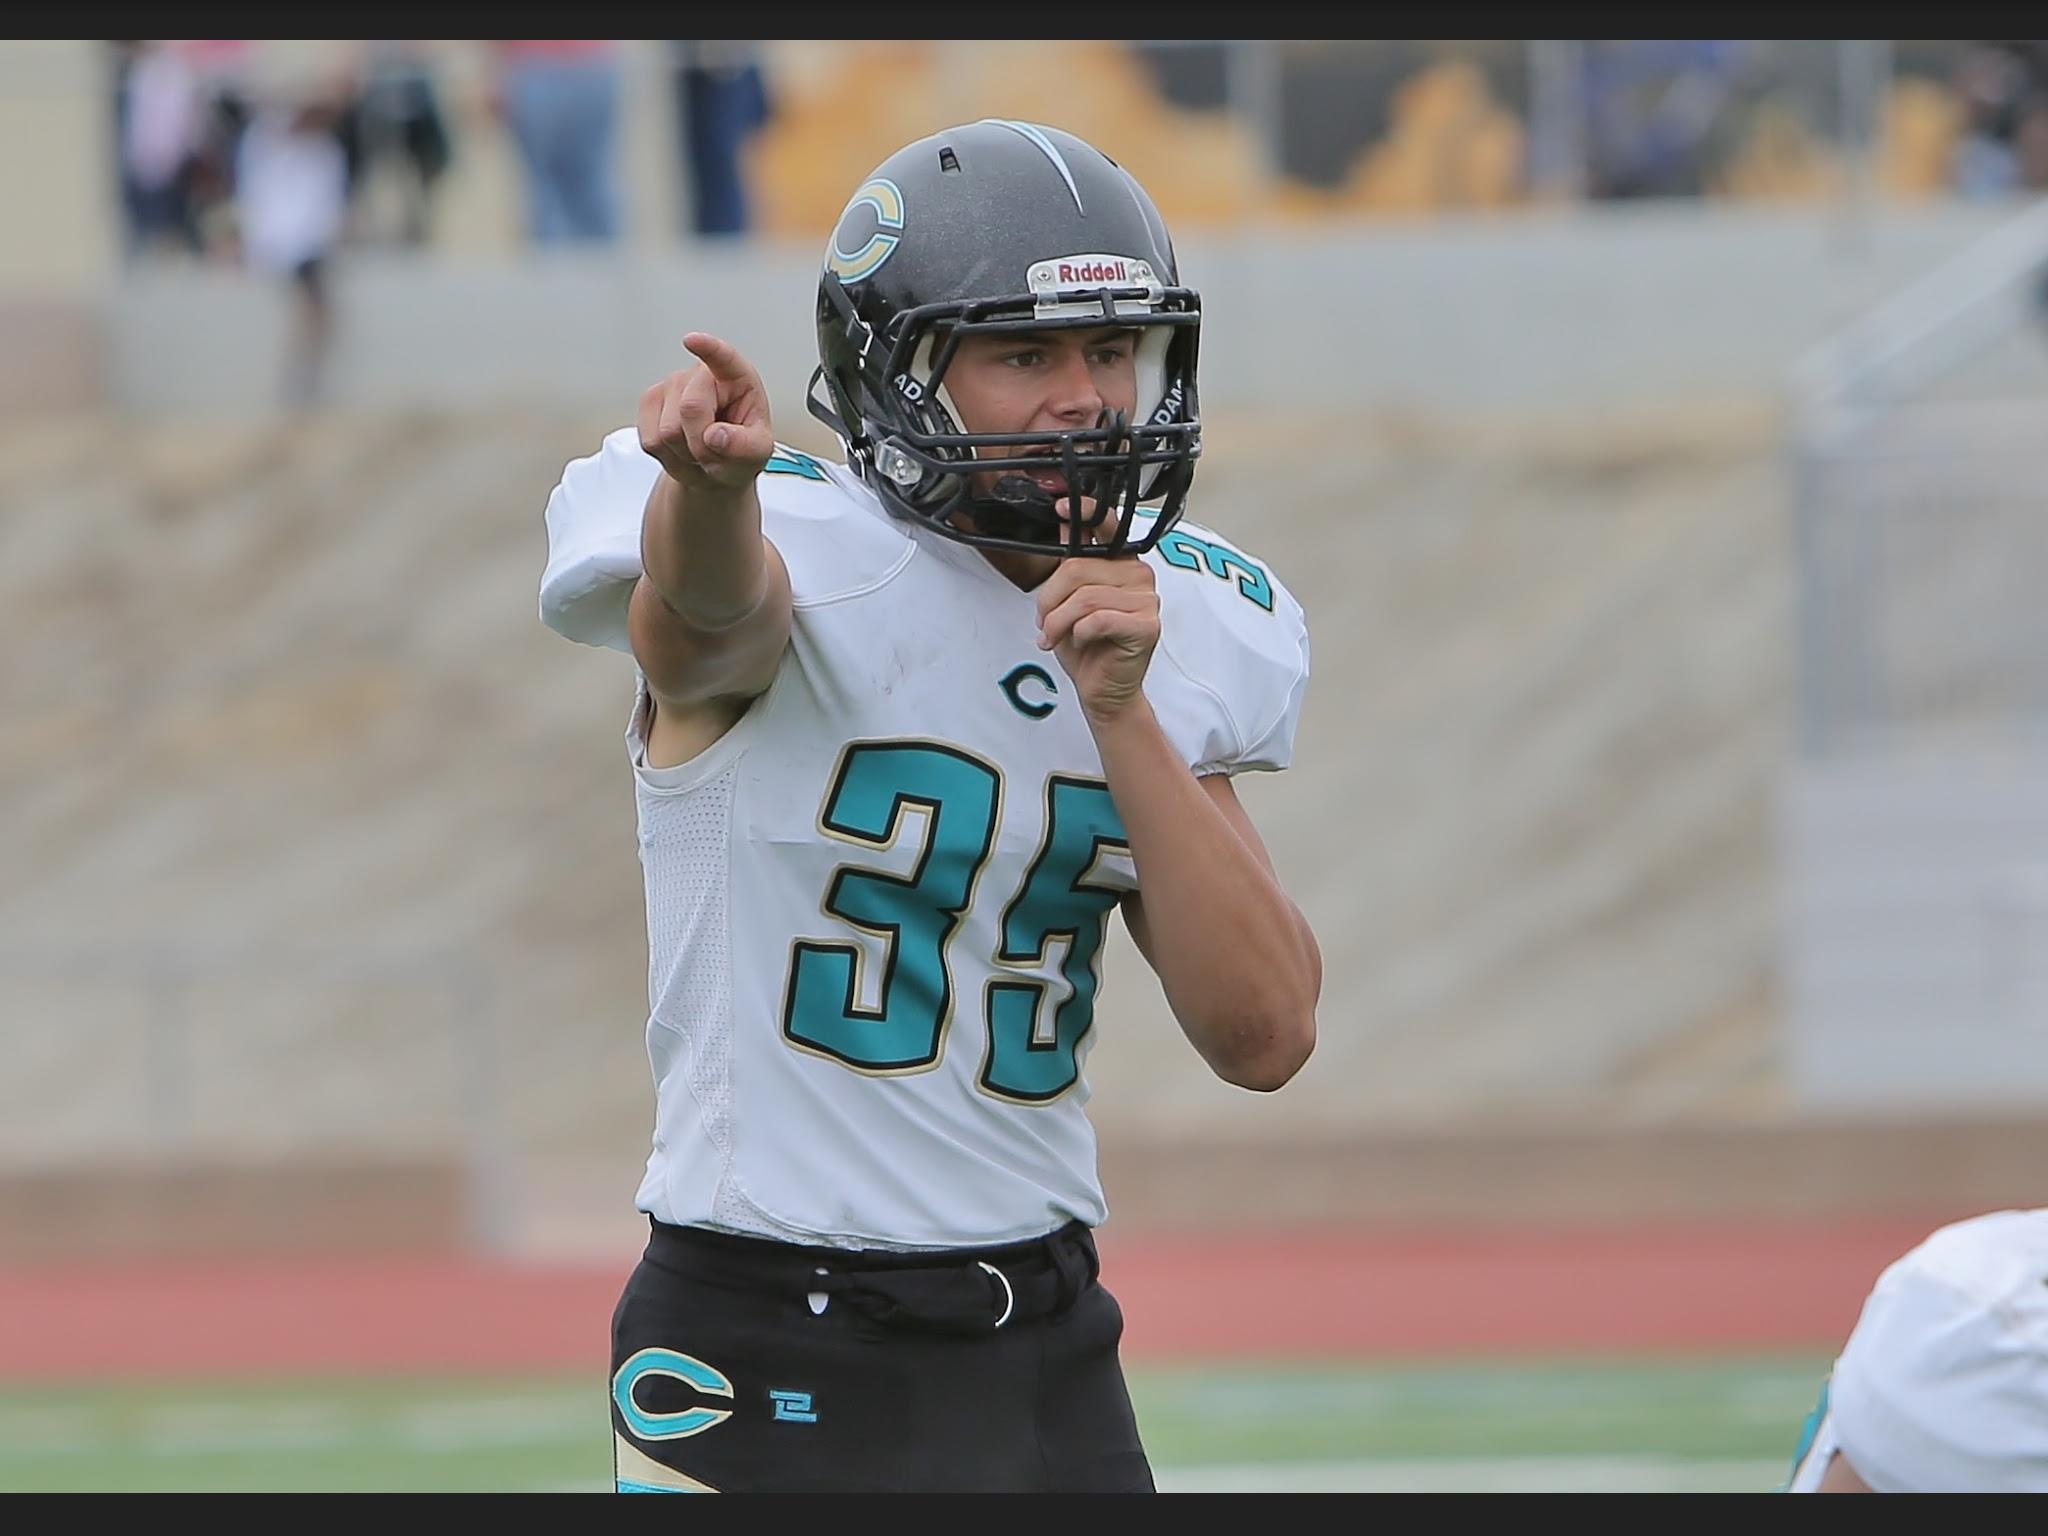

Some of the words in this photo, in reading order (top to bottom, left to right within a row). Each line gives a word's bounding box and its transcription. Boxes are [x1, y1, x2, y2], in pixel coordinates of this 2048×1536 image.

[1058, 261, 1126, 283] Riddell
[894, 373, 924, 406] AD
[997, 660, 1059, 721] C
[781, 737, 1135, 1107] 35
[612, 1347, 734, 1441] C
